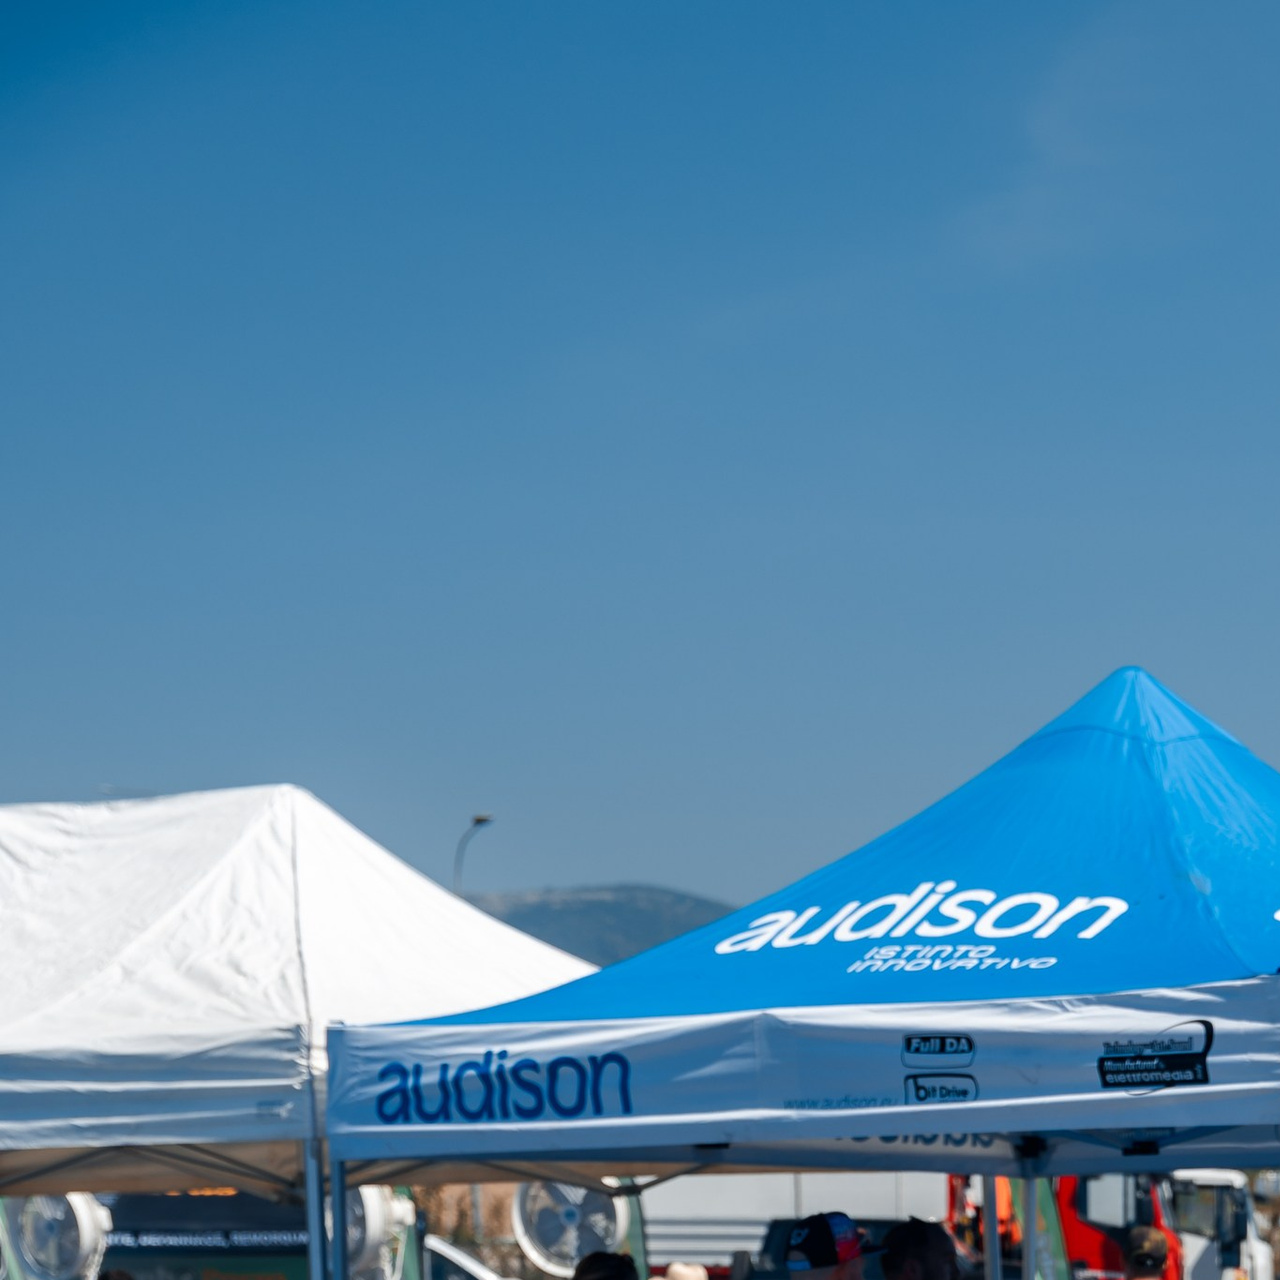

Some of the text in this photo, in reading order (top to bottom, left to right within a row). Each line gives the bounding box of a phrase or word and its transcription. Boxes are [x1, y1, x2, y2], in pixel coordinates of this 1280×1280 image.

[714, 879, 1129, 955] audison
[910, 1037, 969, 1053] Full DA
[376, 1049, 633, 1124] audison
[939, 1085, 970, 1099] Drive
